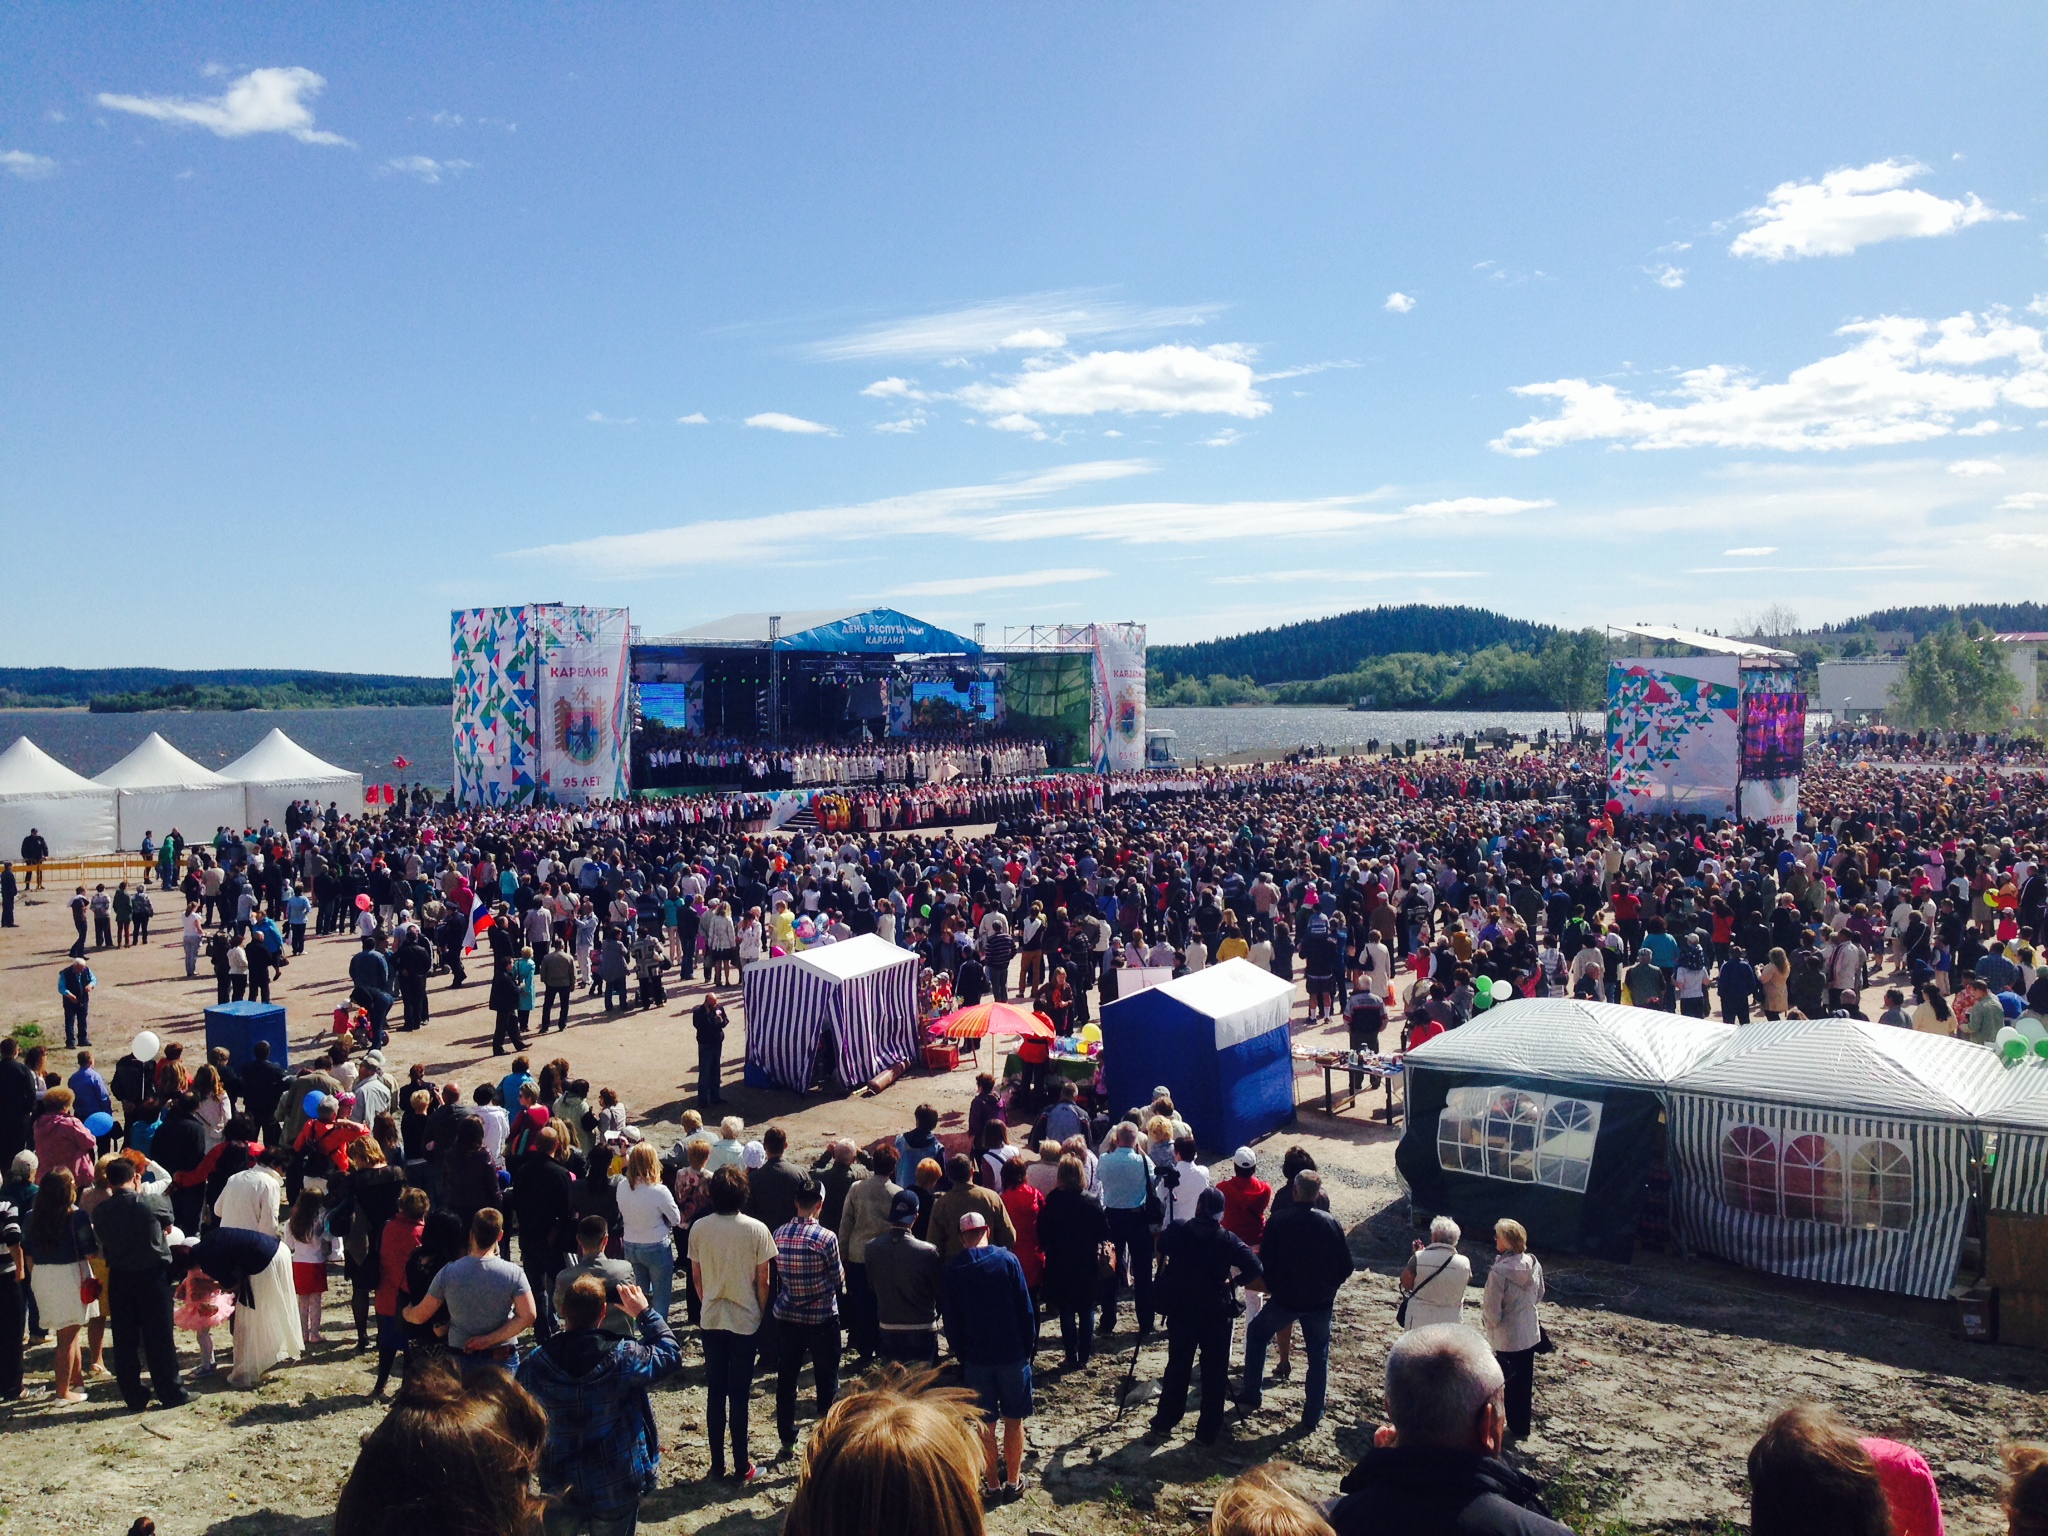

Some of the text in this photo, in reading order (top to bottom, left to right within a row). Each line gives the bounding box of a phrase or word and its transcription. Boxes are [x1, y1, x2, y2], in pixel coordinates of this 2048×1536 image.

[841, 624, 867, 635] ДЕНЬ
[865, 635, 905, 645] КАРЕЛИЯ
[550, 667, 609, 678] КАРЕЛИЯ
[563, 776, 602, 788] 95 ЛЕТ
